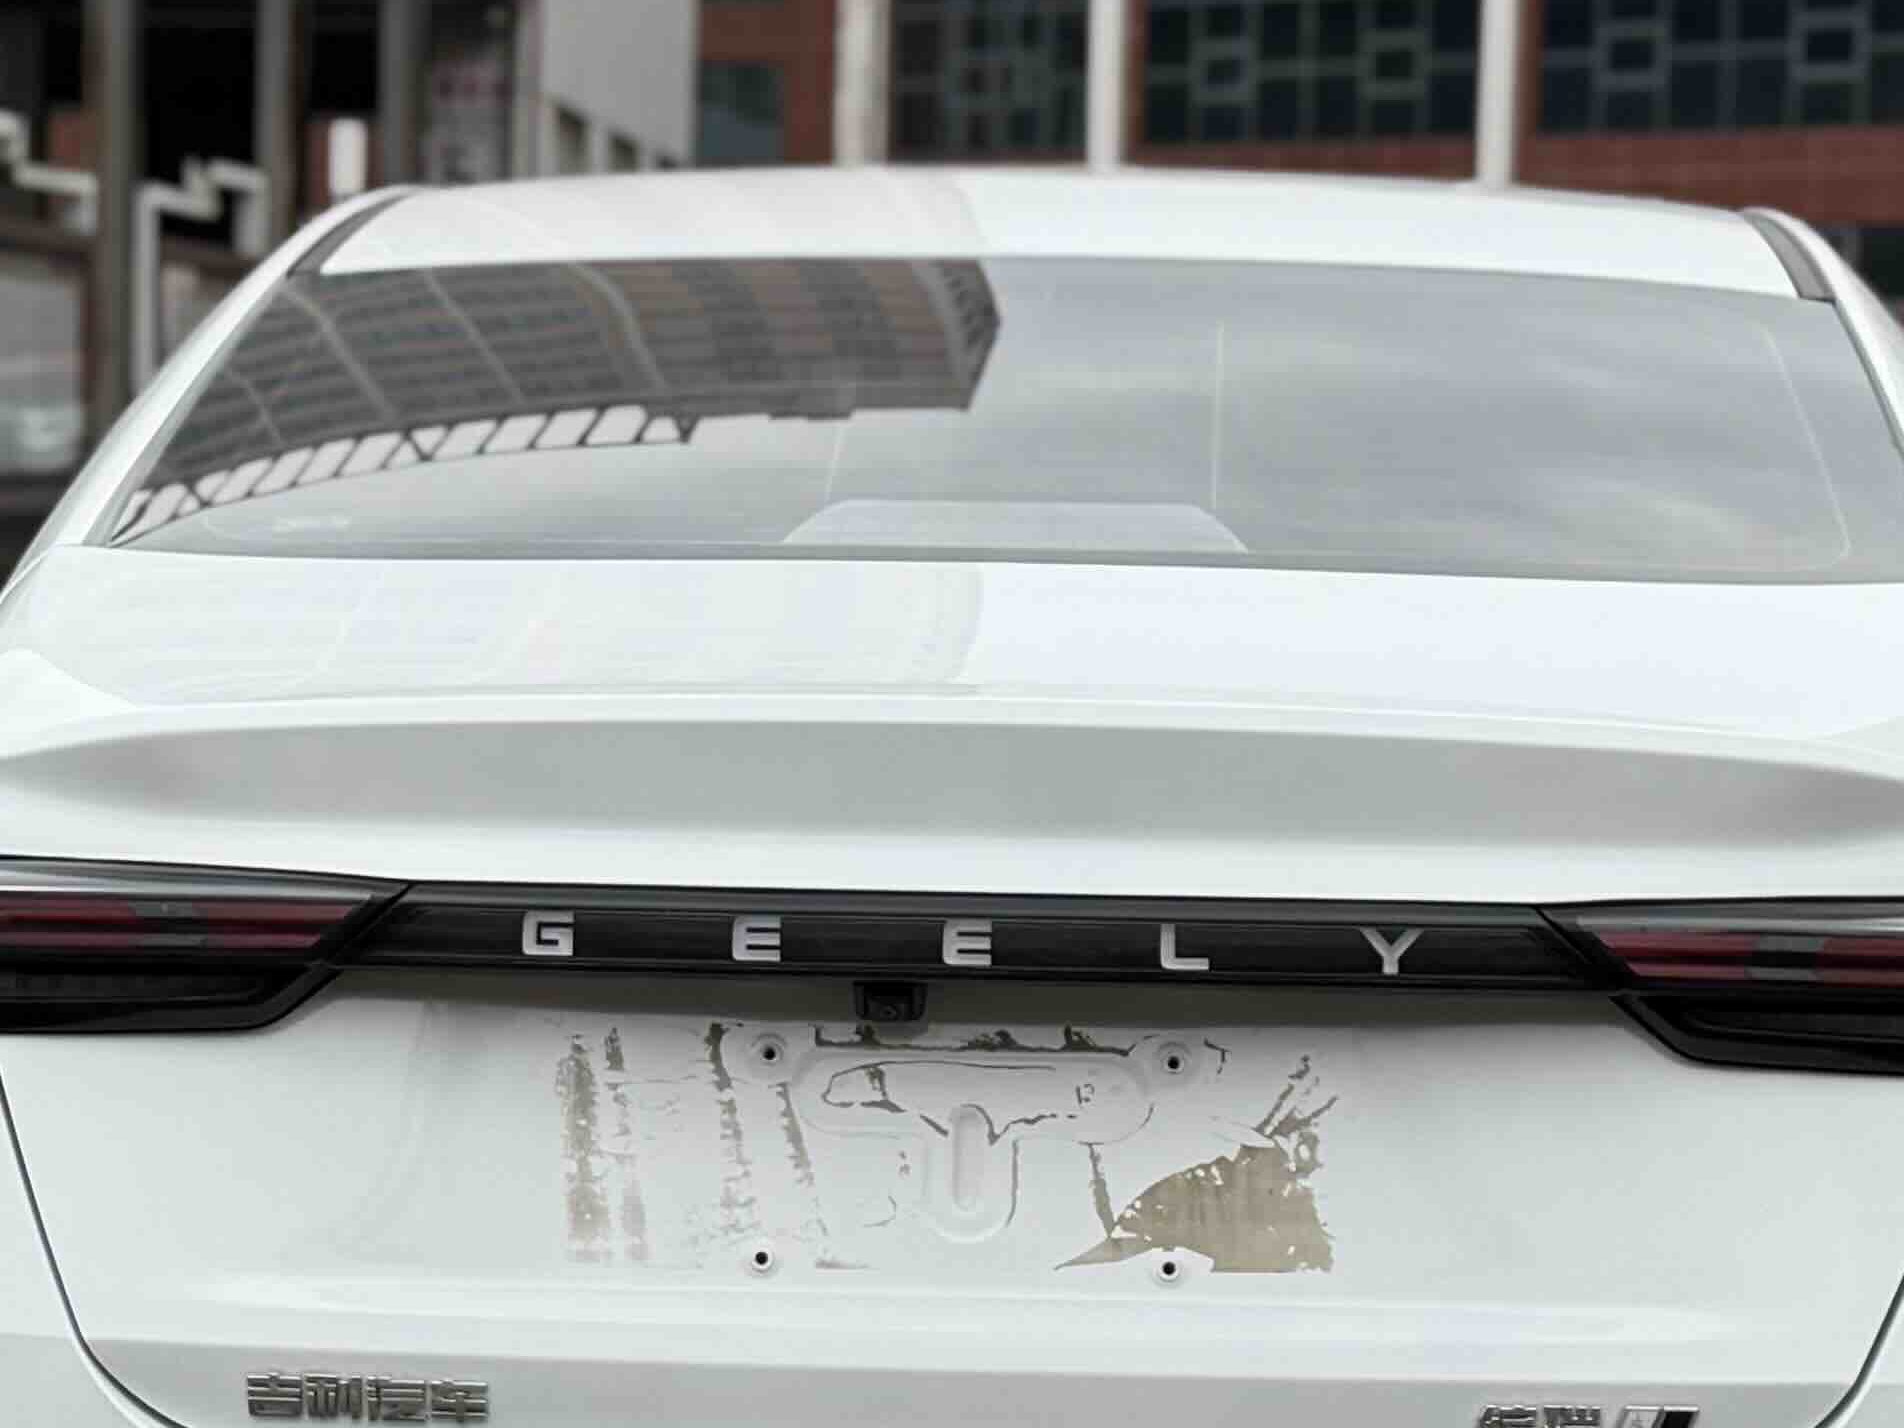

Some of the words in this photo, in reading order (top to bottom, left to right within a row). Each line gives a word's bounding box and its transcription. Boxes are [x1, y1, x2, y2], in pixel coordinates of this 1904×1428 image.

[522, 910, 1424, 974] GEELY
[247, 1372, 489, 1421] 吉利汽车
